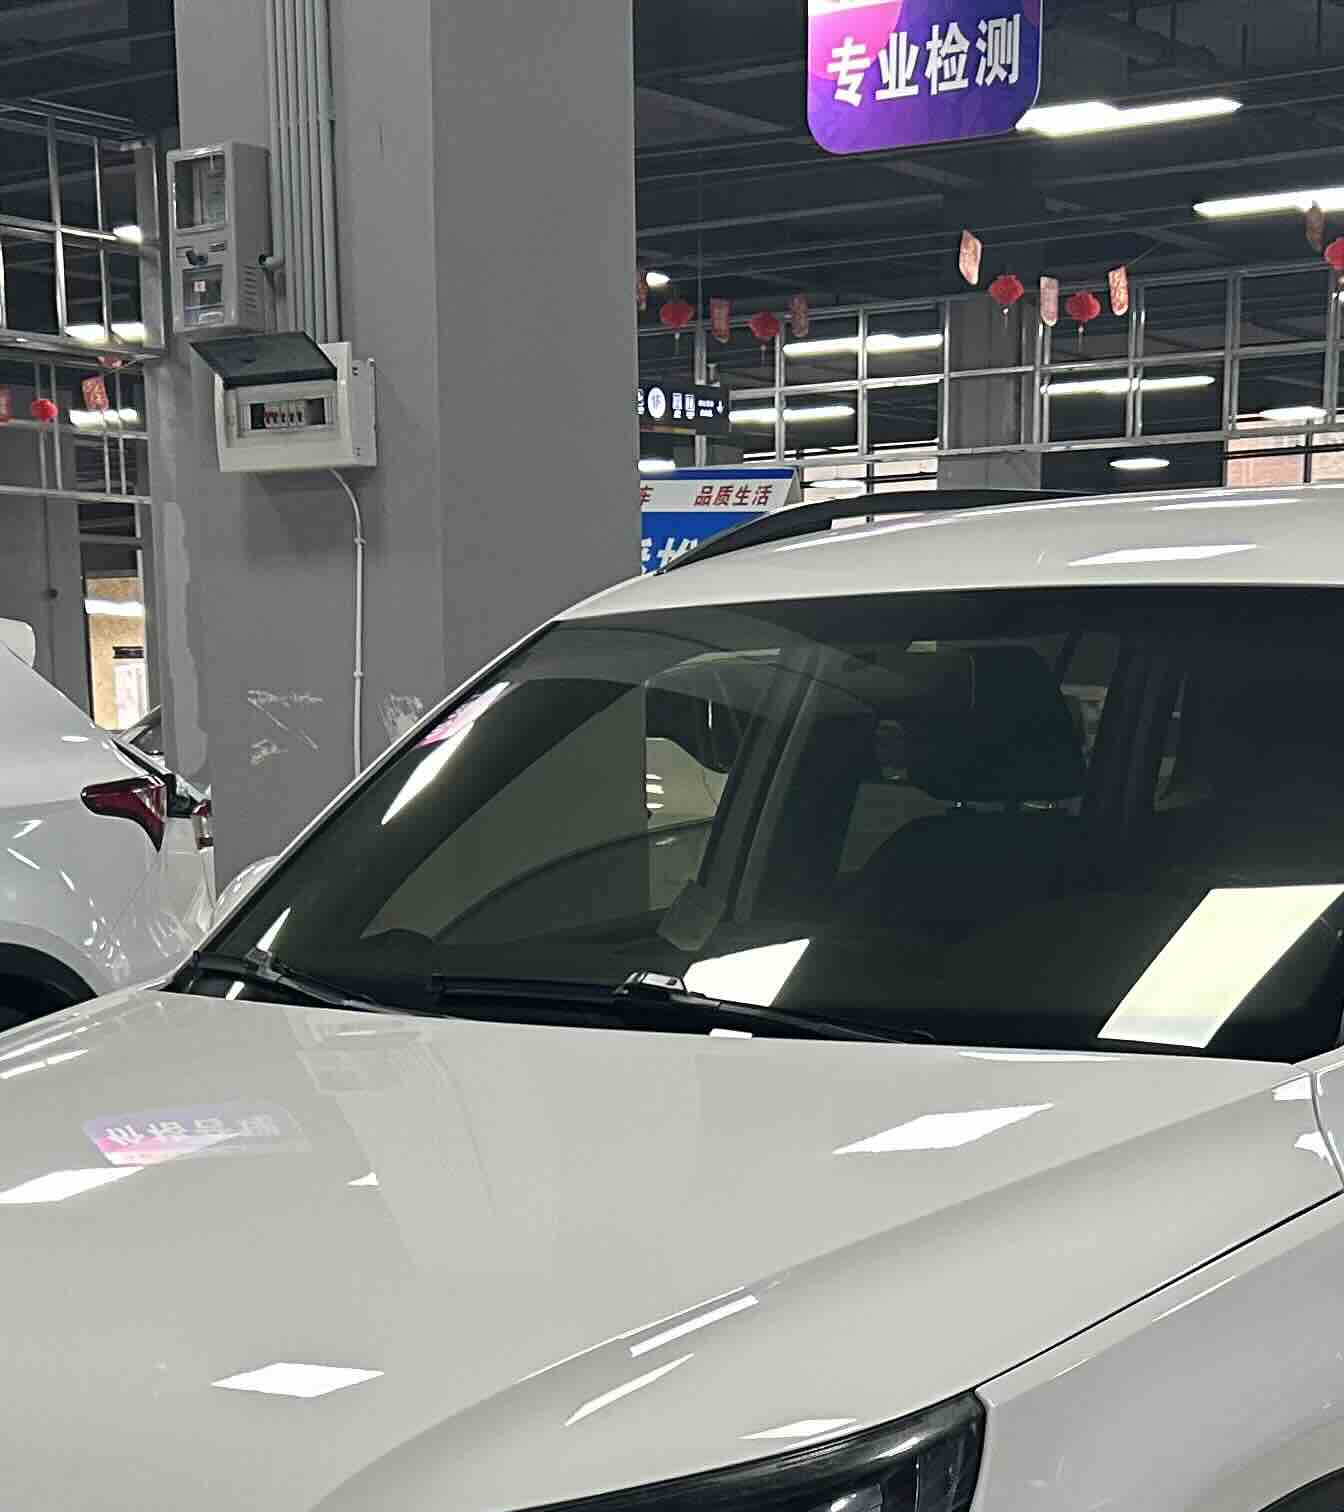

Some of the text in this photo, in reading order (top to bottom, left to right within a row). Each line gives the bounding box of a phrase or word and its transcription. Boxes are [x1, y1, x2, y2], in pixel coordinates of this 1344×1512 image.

[827, 14, 1021, 107] 专业检测
[693, 484, 772, 506] 品质生活
